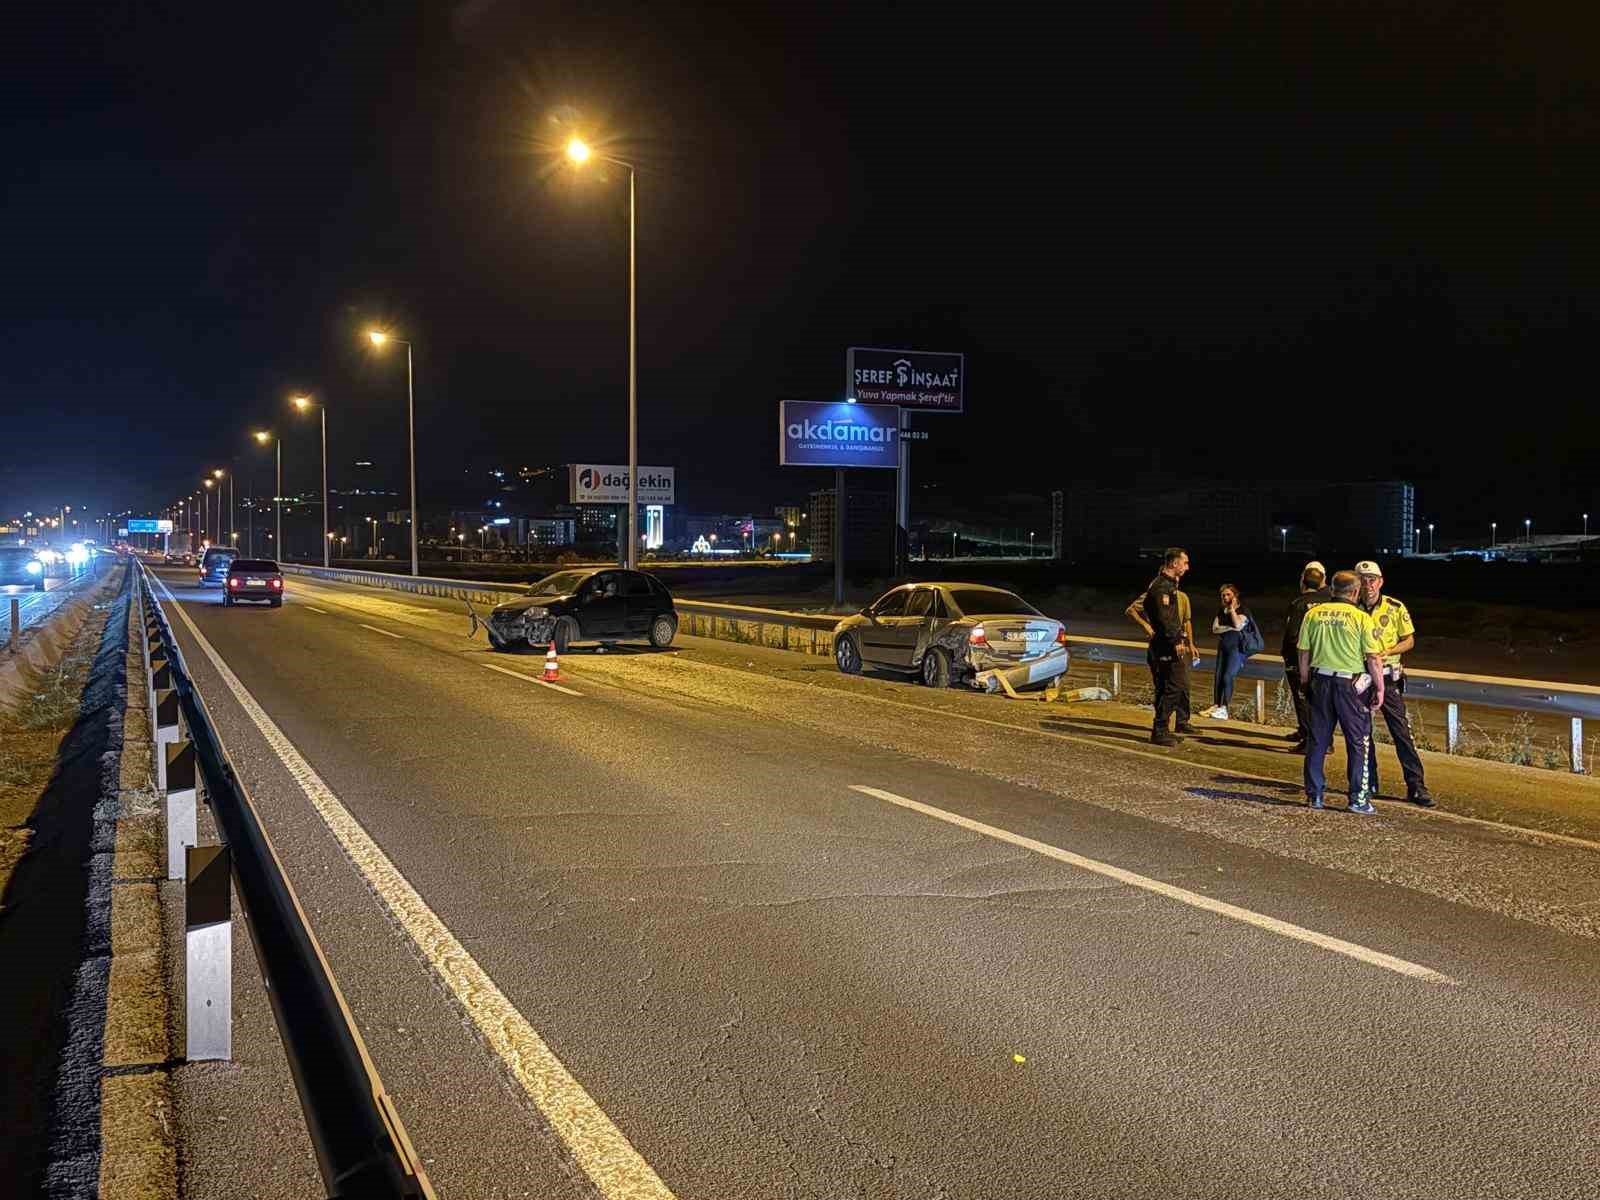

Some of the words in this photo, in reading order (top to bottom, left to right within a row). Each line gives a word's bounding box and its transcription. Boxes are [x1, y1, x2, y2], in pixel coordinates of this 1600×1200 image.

[855, 368, 893, 385] ŞEREF
[857, 389, 879, 399] Yuva
[880, 390, 917, 402] Yapmak
[787, 418, 897, 442] akdamar
[602, 472, 672, 490] dağekin
